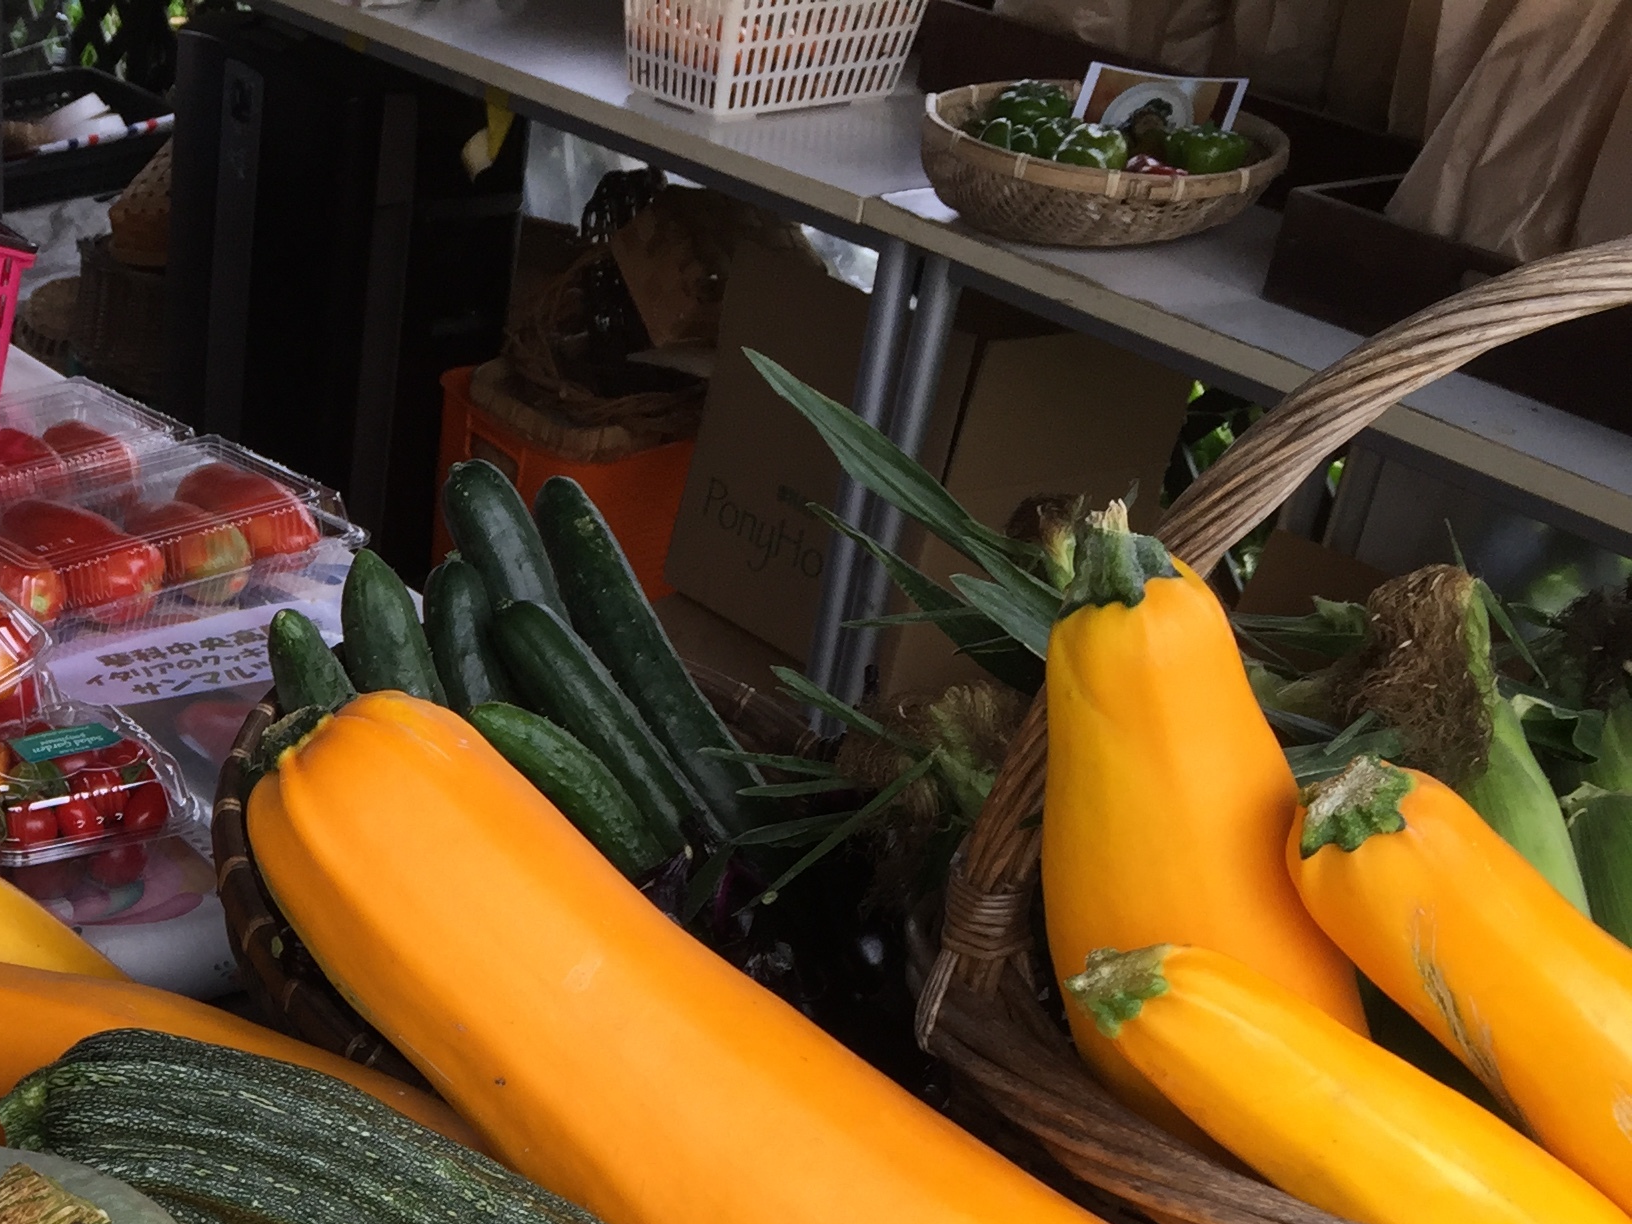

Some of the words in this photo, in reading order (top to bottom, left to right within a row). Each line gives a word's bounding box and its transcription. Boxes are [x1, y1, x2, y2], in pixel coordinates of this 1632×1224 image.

[85, 643, 270, 687] イタリアのクッキ
[31, 740, 72, 754] Garden
[73, 734, 104, 747] Salad
